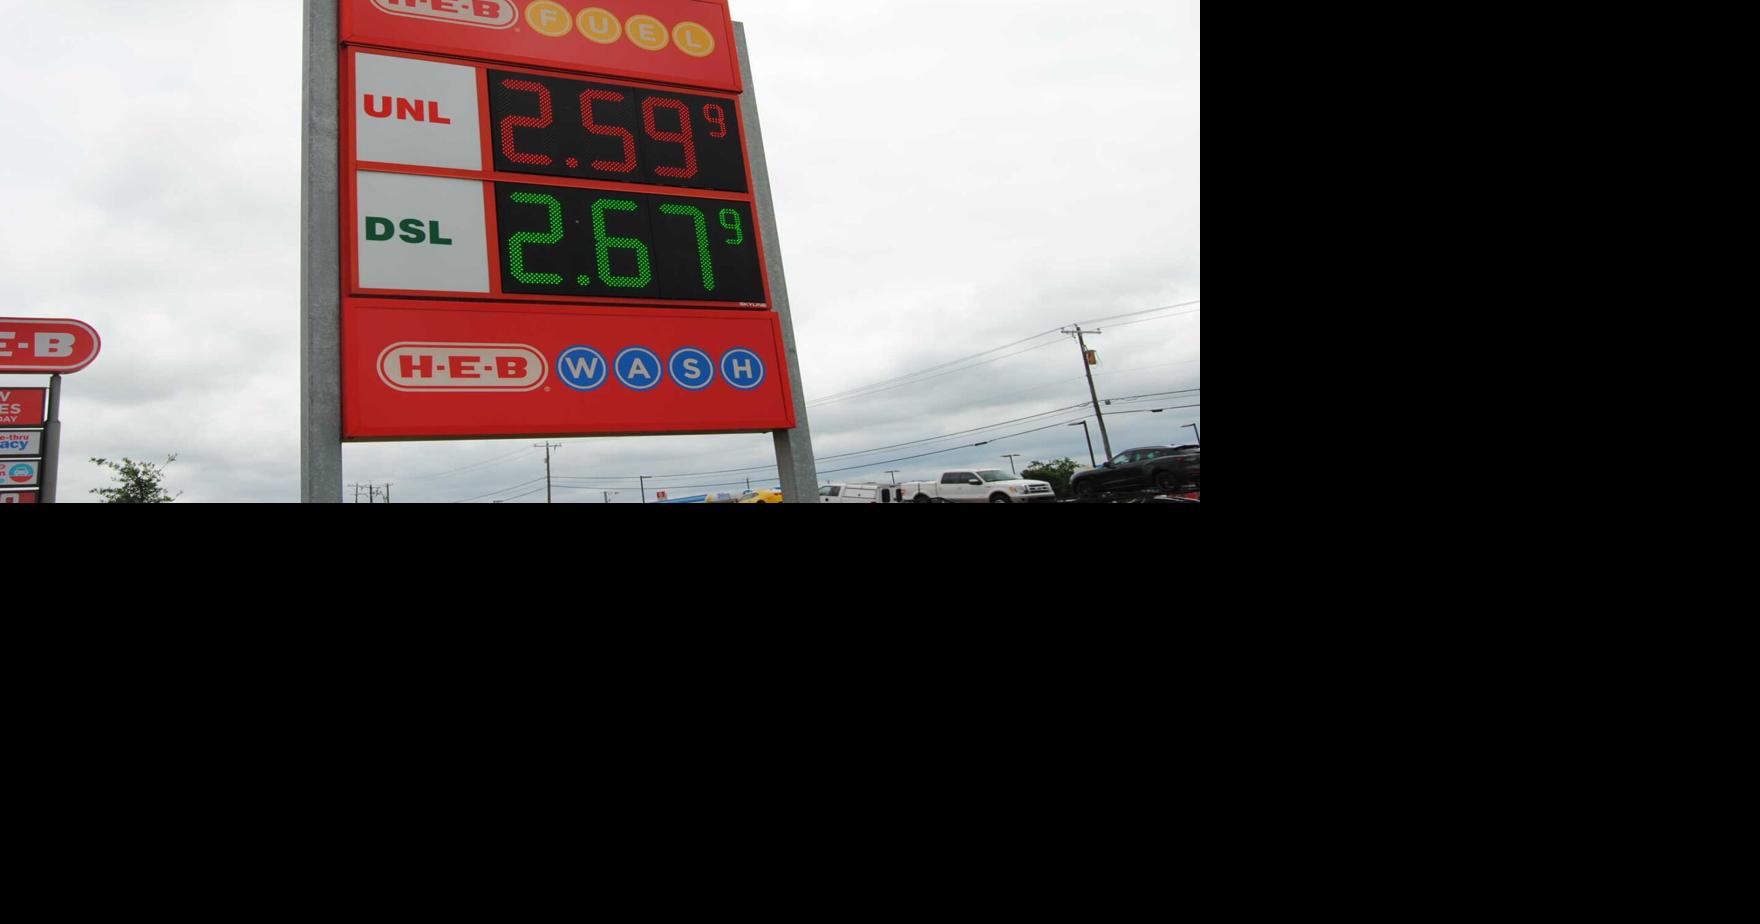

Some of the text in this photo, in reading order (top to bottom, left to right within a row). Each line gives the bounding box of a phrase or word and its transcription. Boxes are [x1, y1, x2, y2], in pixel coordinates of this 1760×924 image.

[388, 0, 704, 49] -E-B FUEL
[363, 94, 451, 125] UNL
[500, 78, 728, 179] 2.59 9
[365, 216, 453, 246] DSL
[508, 192, 743, 291] 2.67 9
[398, 355, 755, 382] H-E-B WASH
